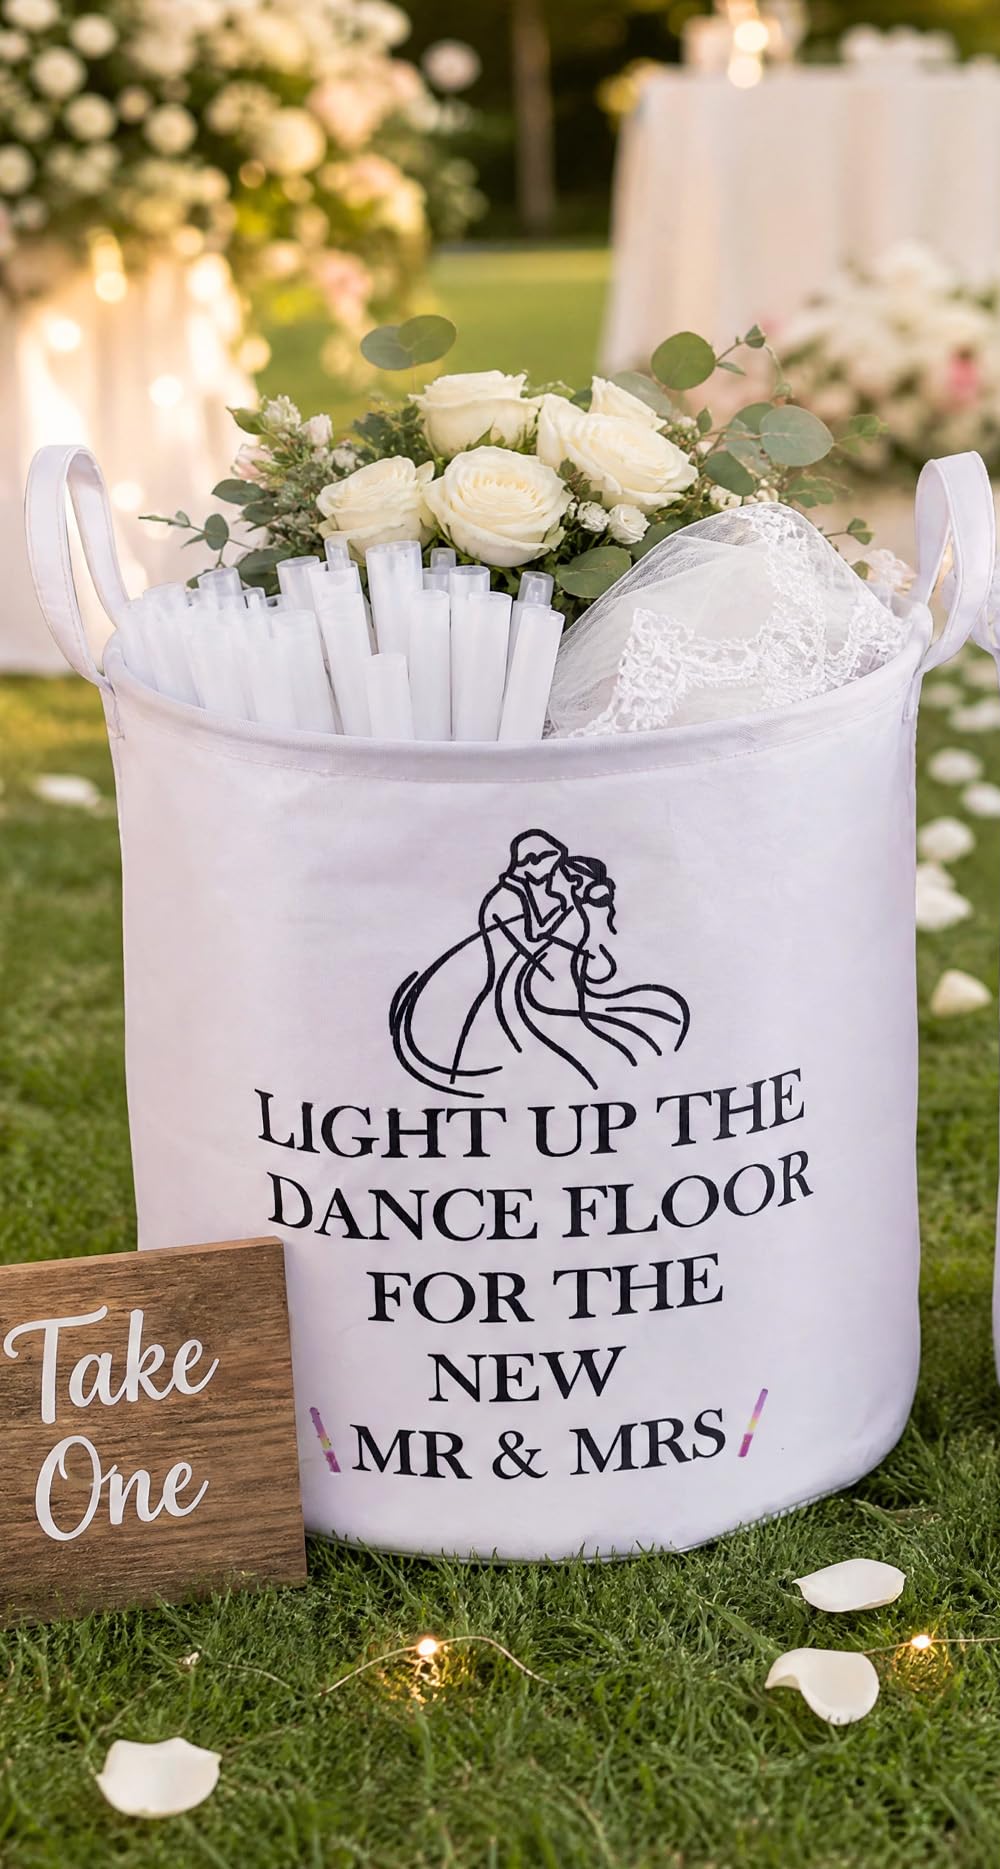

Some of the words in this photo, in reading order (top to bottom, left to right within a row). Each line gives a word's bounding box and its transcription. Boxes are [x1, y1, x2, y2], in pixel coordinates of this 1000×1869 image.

[254, 1088, 506, 1158] LIGHT
[528, 1102, 636, 1157] UP
[657, 1068, 805, 1146] THE
[267, 1172, 537, 1241] DANCE
[562, 1151, 813, 1237] FLOOR
[367, 1272, 534, 1323] FOR
[553, 1253, 723, 1319] THE
[3, 1305, 220, 1424] Take
[428, 1346, 626, 1402] NEW
[35, 1435, 209, 1541] One
[350, 1424, 472, 1479] MR
[493, 1431, 547, 1479] &
[569, 1409, 725, 1475] MRS
